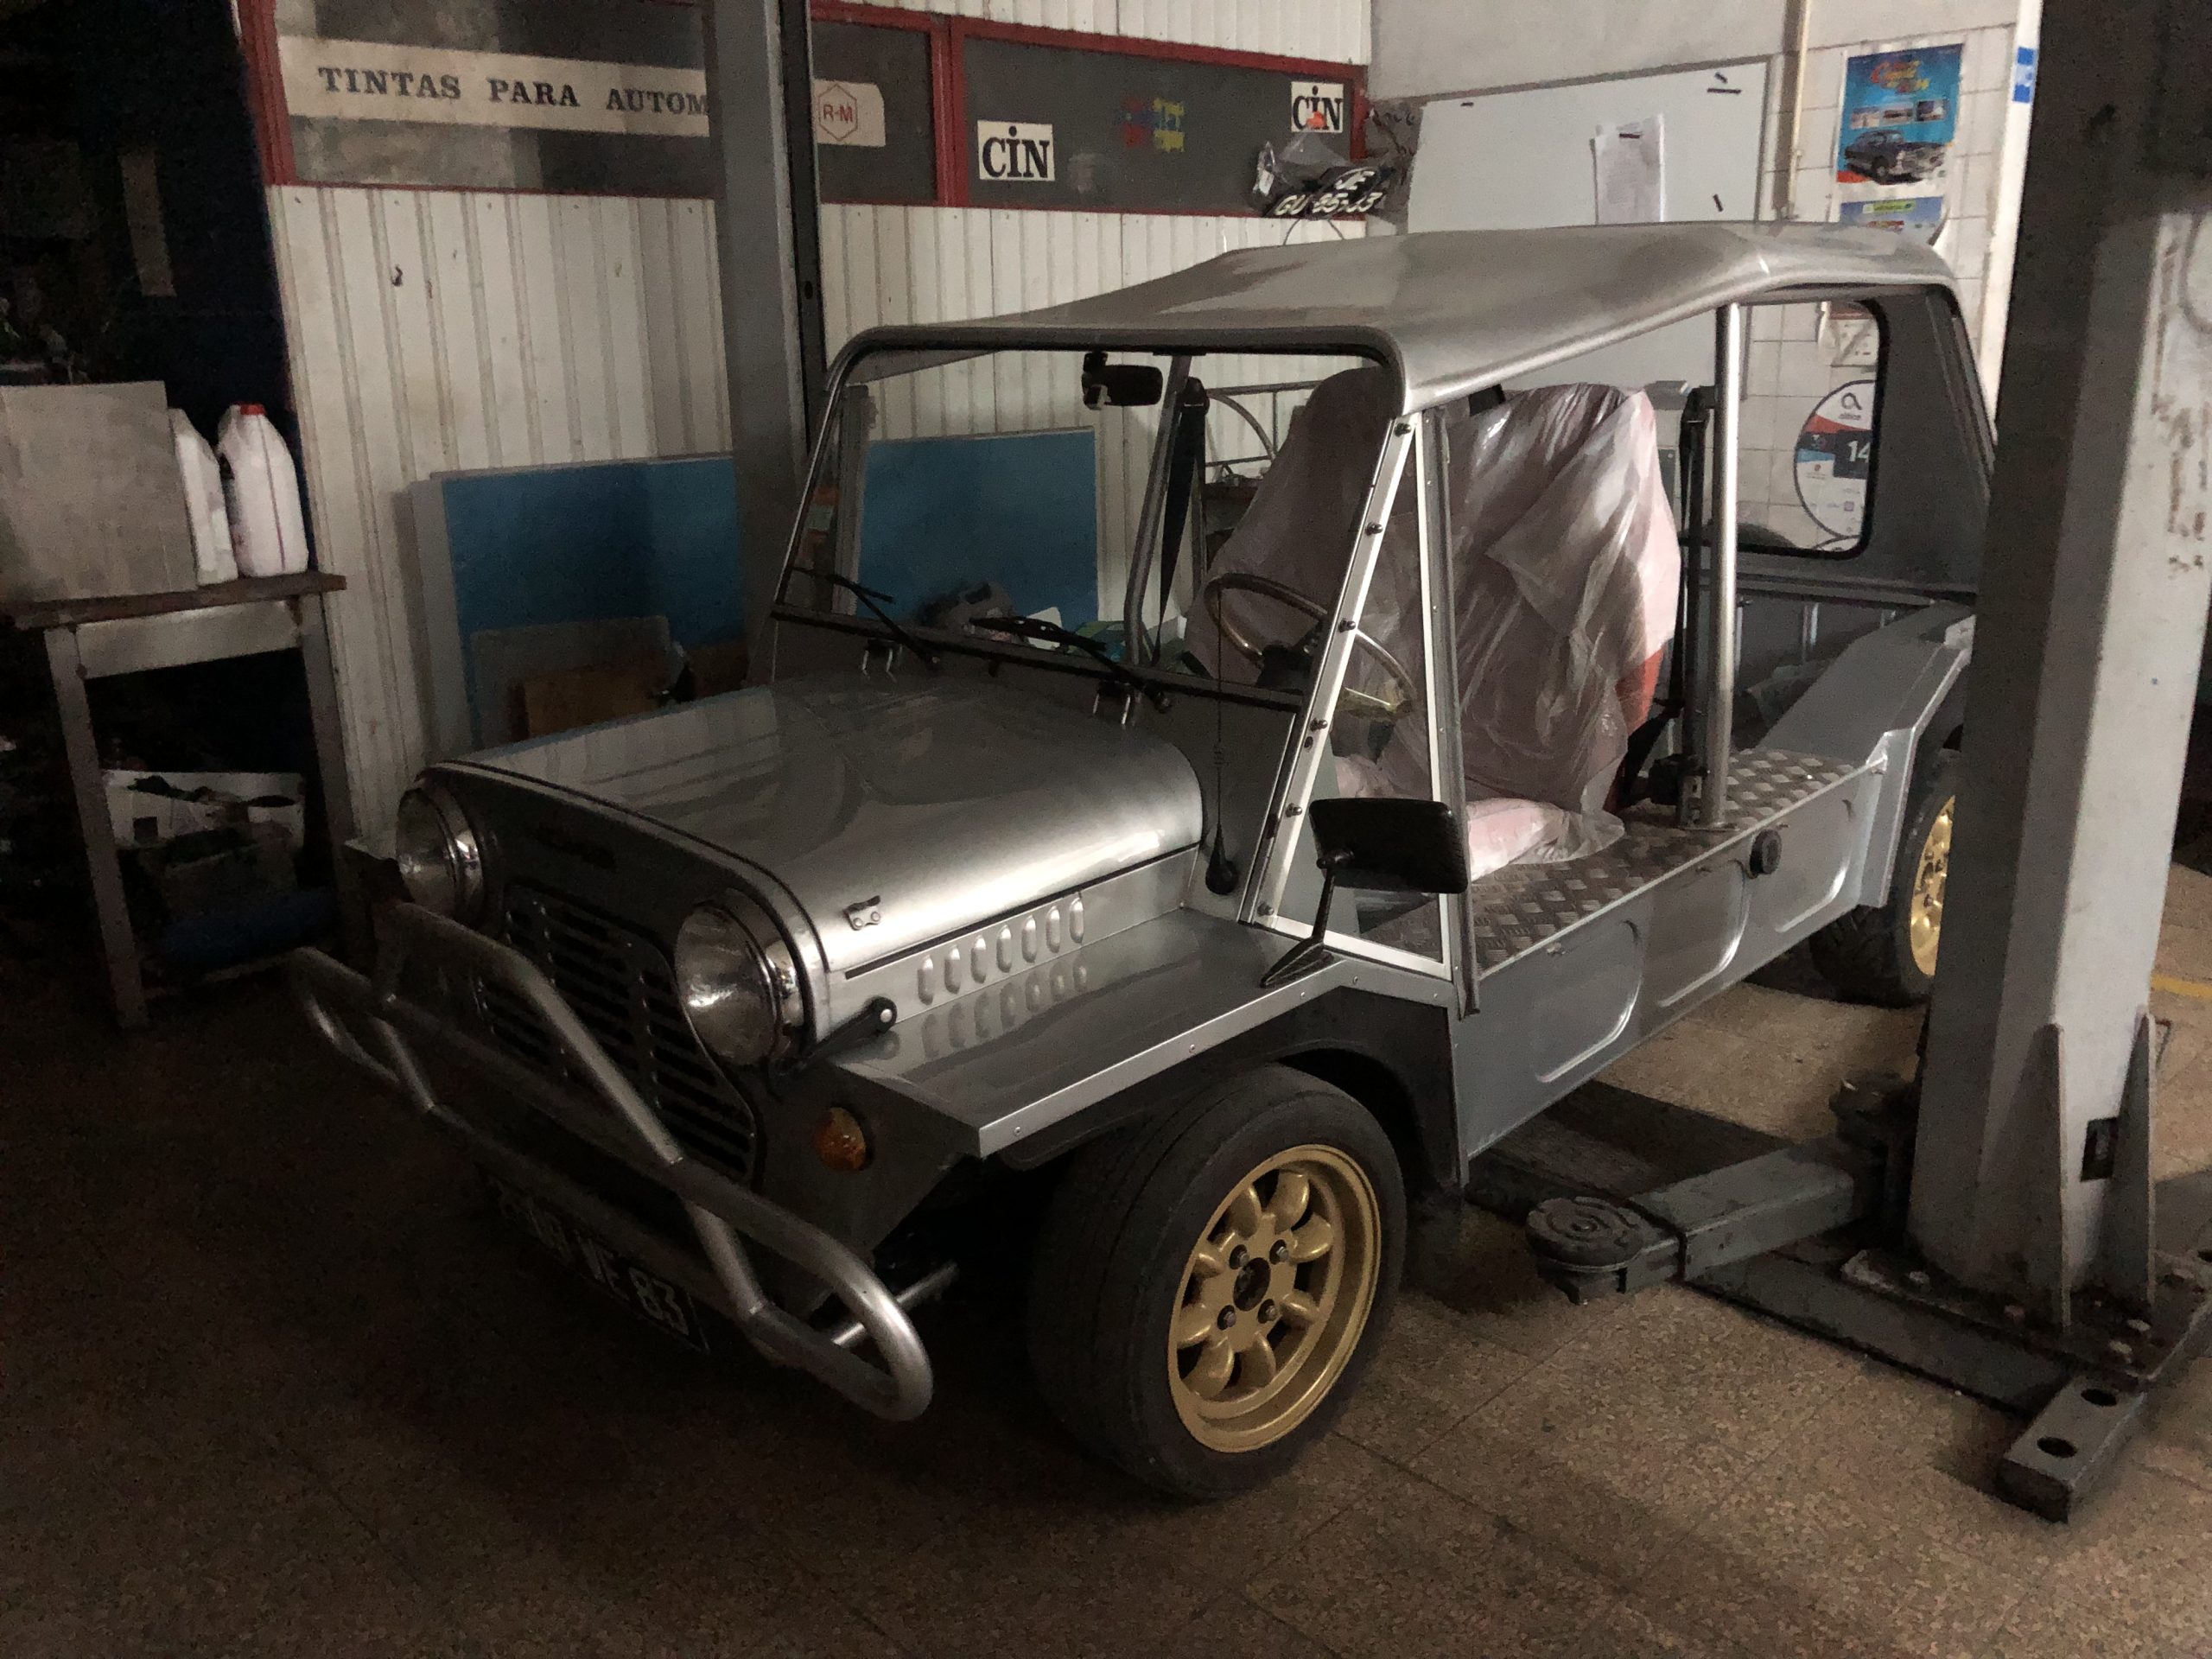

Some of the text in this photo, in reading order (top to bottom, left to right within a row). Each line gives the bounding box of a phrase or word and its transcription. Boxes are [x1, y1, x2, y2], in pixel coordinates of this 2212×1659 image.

[318, 67, 709, 115] TINTAS PARA AUTOM
[823, 104, 853, 123] R-M
[628, 1267, 690, 1336] 83
